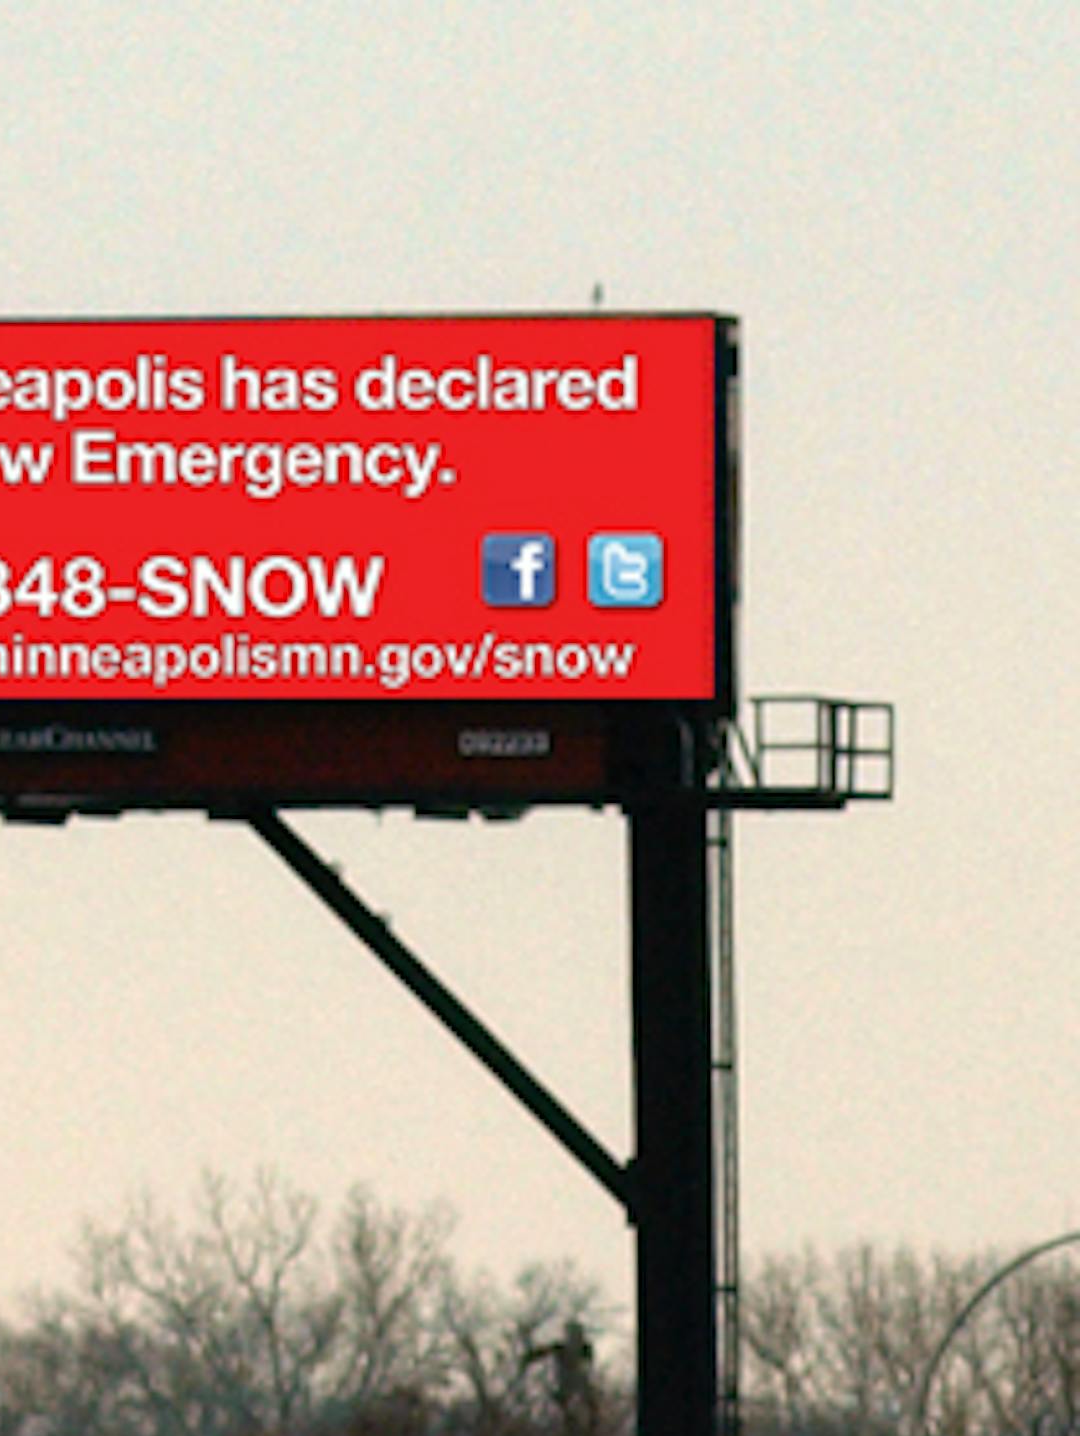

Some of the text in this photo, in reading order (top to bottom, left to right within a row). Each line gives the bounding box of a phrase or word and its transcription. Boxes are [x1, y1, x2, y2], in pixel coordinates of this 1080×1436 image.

[221, 355, 339, 411] has
[354, 355, 638, 411] declared
[73, 429, 456, 498] Emergency.
